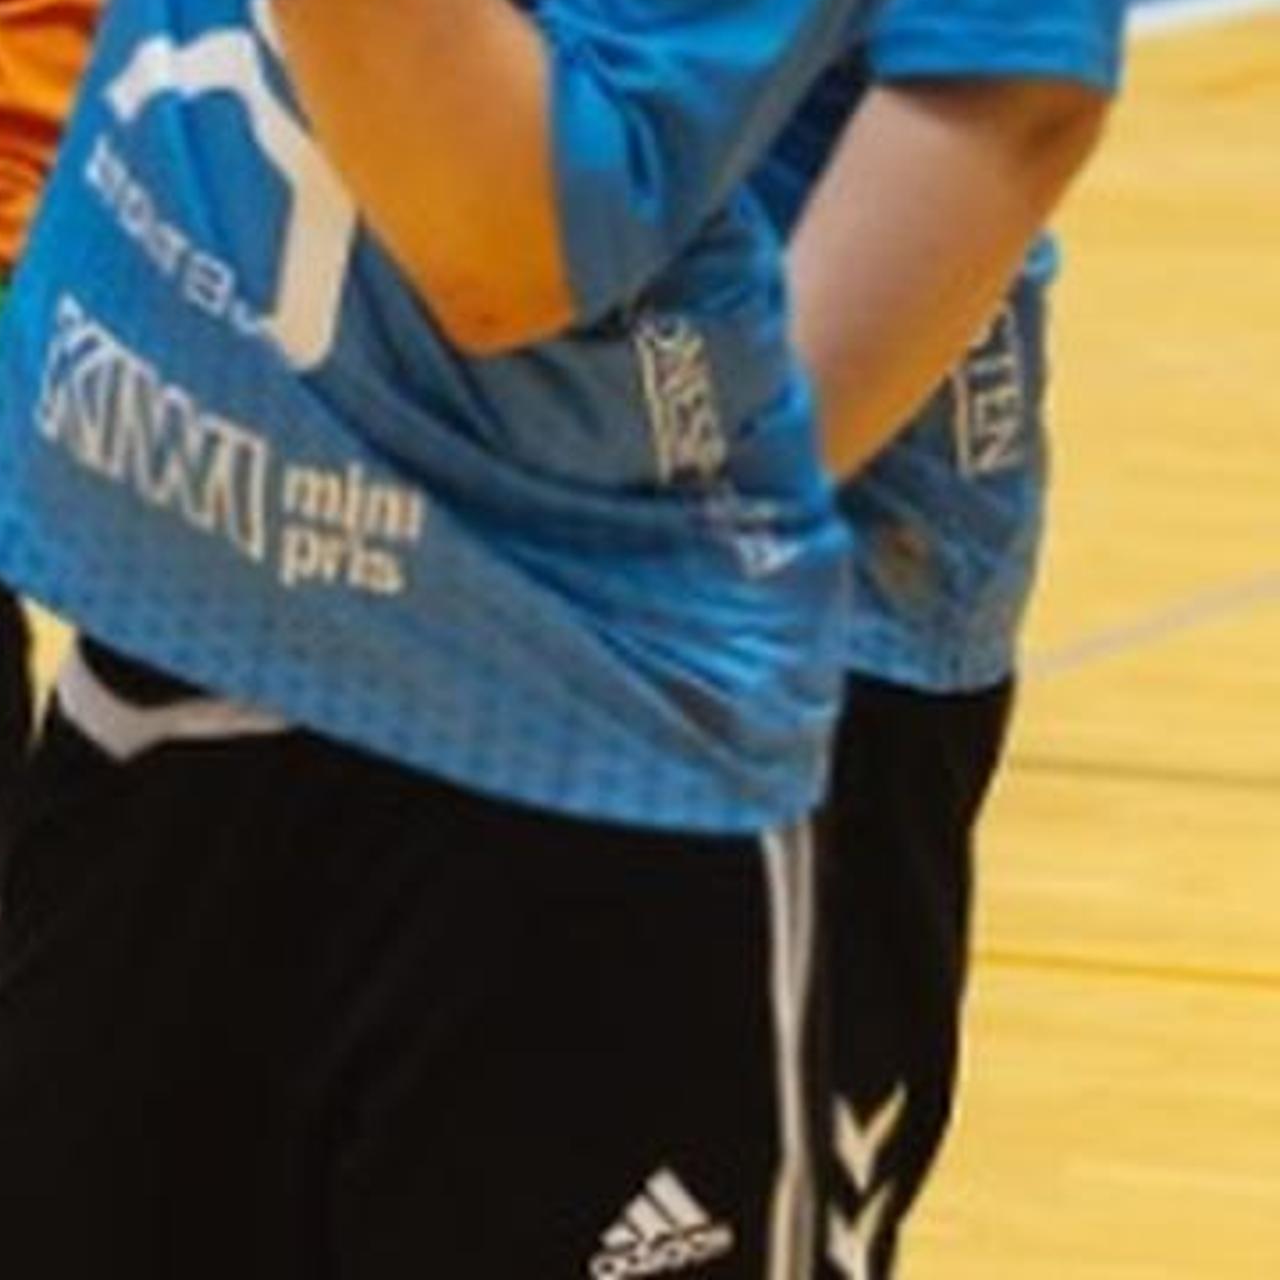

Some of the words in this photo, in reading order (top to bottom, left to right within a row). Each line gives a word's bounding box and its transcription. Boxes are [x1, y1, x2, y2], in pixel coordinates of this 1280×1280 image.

[38, 290, 267, 562] KIWI
[282, 460, 425, 540] mini
[277, 520, 406, 596] pris
